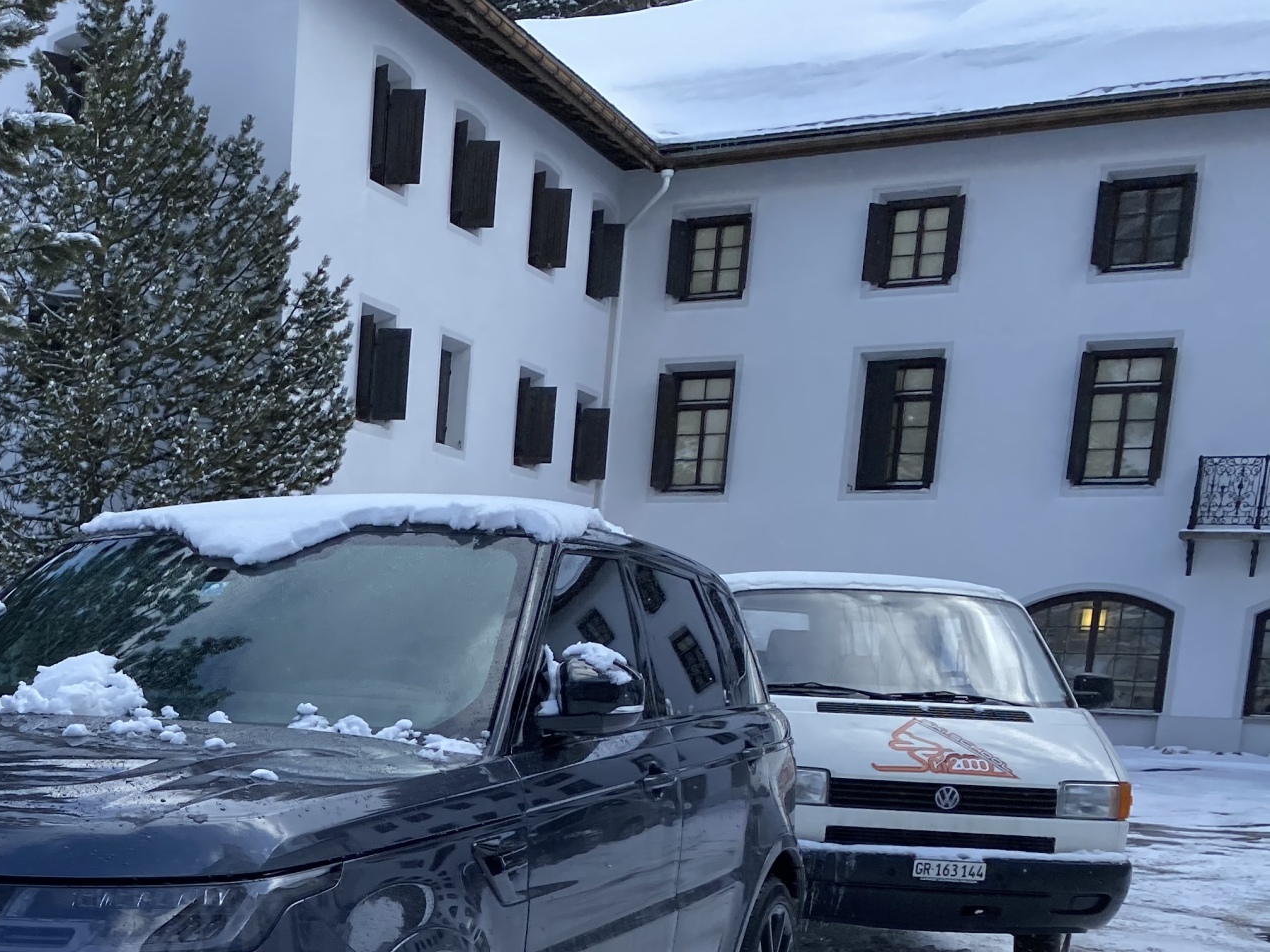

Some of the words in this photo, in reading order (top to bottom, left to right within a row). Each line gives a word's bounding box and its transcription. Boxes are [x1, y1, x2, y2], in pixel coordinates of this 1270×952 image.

[949, 757, 990, 772] 2000
[935, 786, 959, 809] VW
[915, 862, 931, 876] GR
[935, 863, 958, 877] 163
[961, 865, 984, 878] 144
